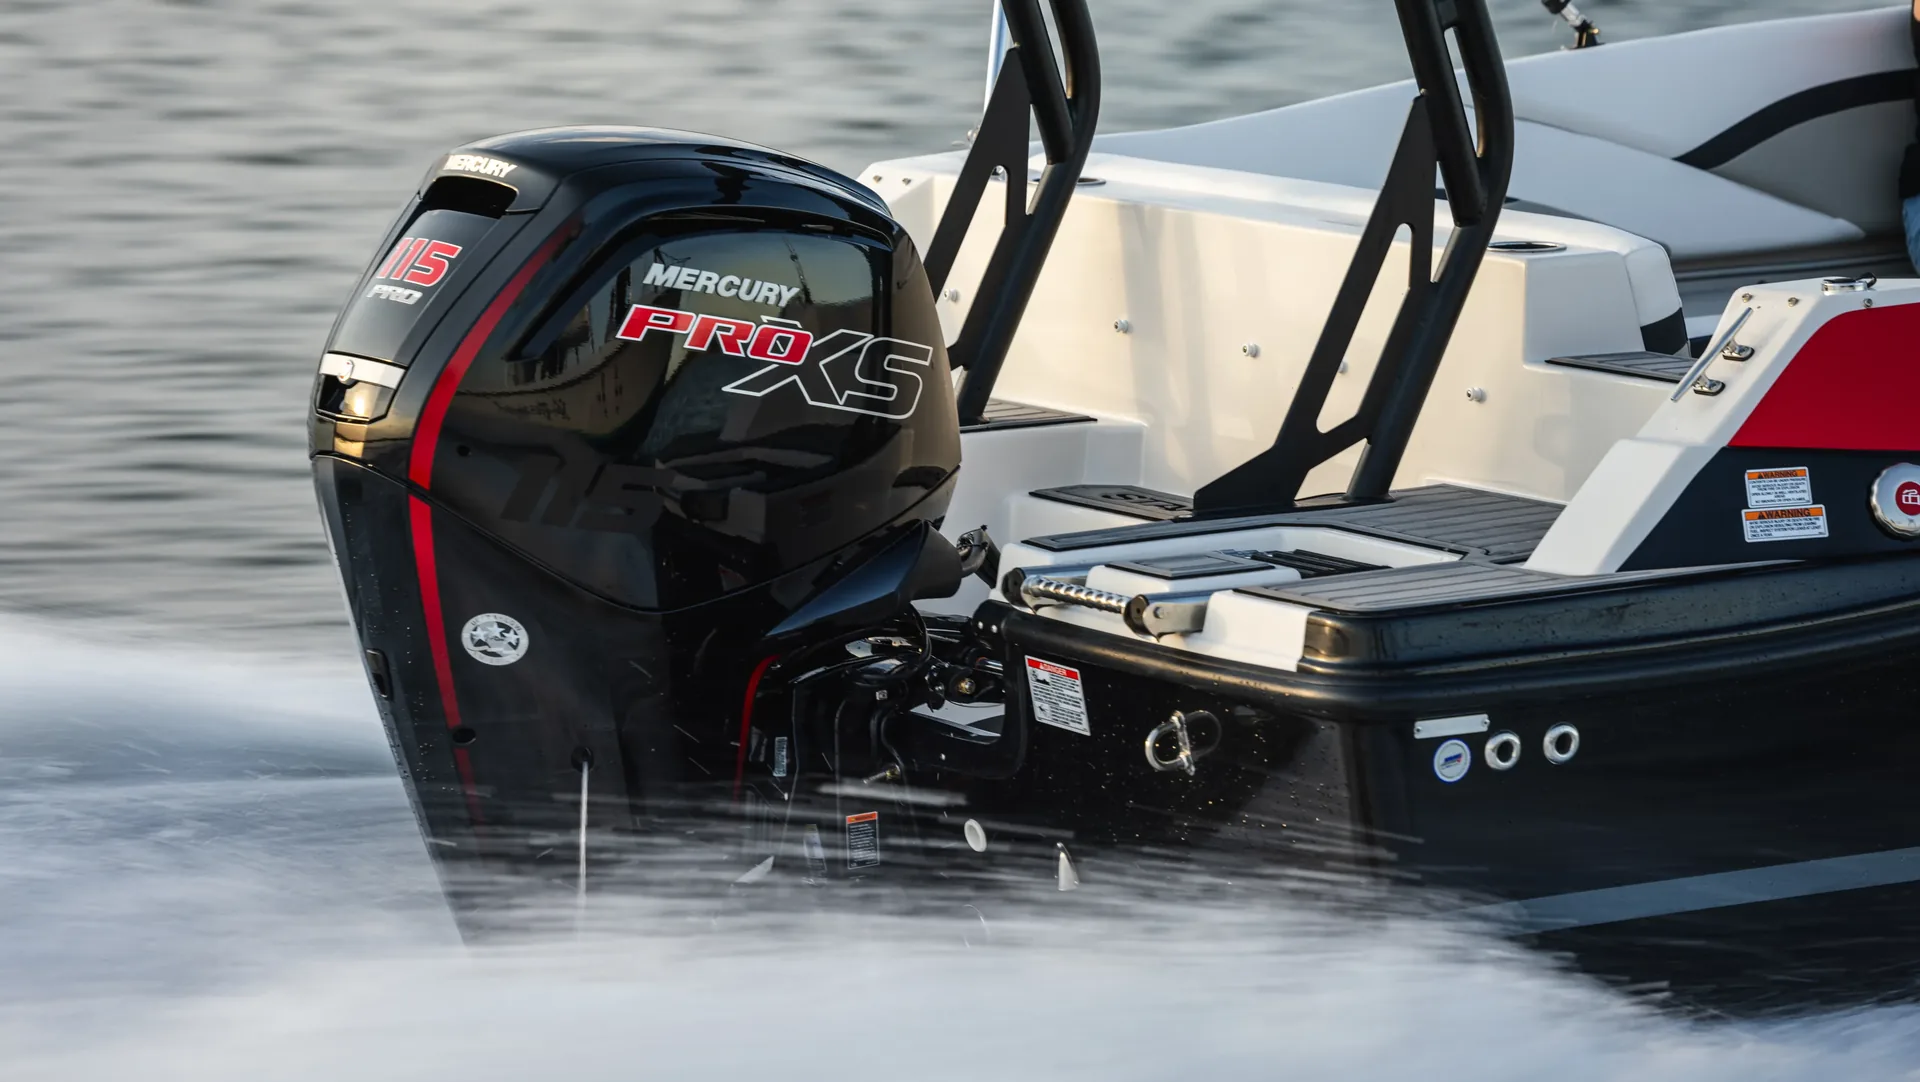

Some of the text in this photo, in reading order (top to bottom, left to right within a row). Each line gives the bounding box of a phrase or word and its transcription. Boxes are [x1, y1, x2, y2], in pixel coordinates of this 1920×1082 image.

[443, 155, 517, 178] MERCURY
[376, 237, 463, 287] 115
[366, 284, 423, 305] PRO
[643, 263, 800, 307] MERCURY
[1763, 470, 1798, 479] WARNING
[1765, 508, 1811, 519] WARNING
